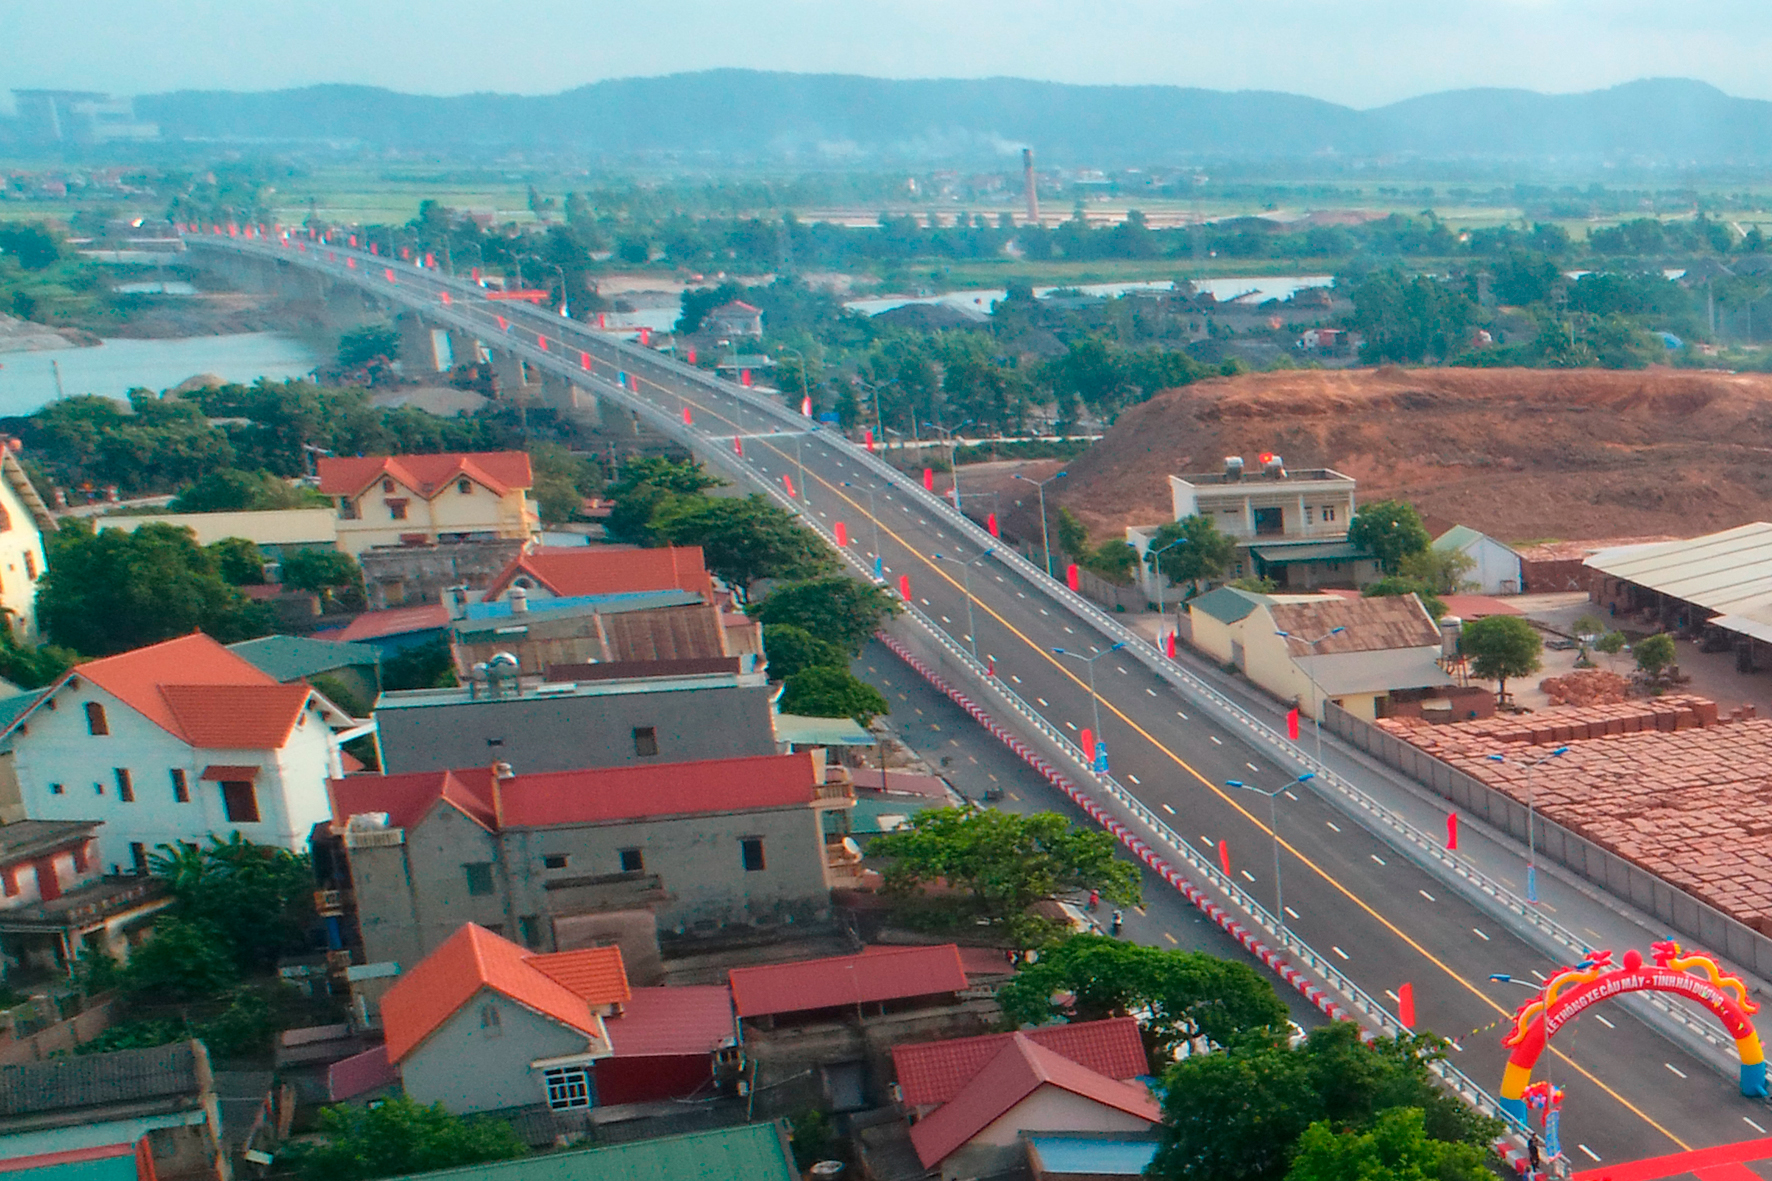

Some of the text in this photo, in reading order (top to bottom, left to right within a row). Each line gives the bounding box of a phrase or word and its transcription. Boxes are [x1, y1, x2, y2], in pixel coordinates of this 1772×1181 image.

[1555, 996, 1588, 1023] THÔNG
[1585, 988, 1600, 1003] XE
[1599, 979, 1621, 997] CẦU
[1621, 974, 1645, 990] MÂY
[1652, 971, 1676, 987] TỈNH
[1676, 975, 1693, 991] HẢI
